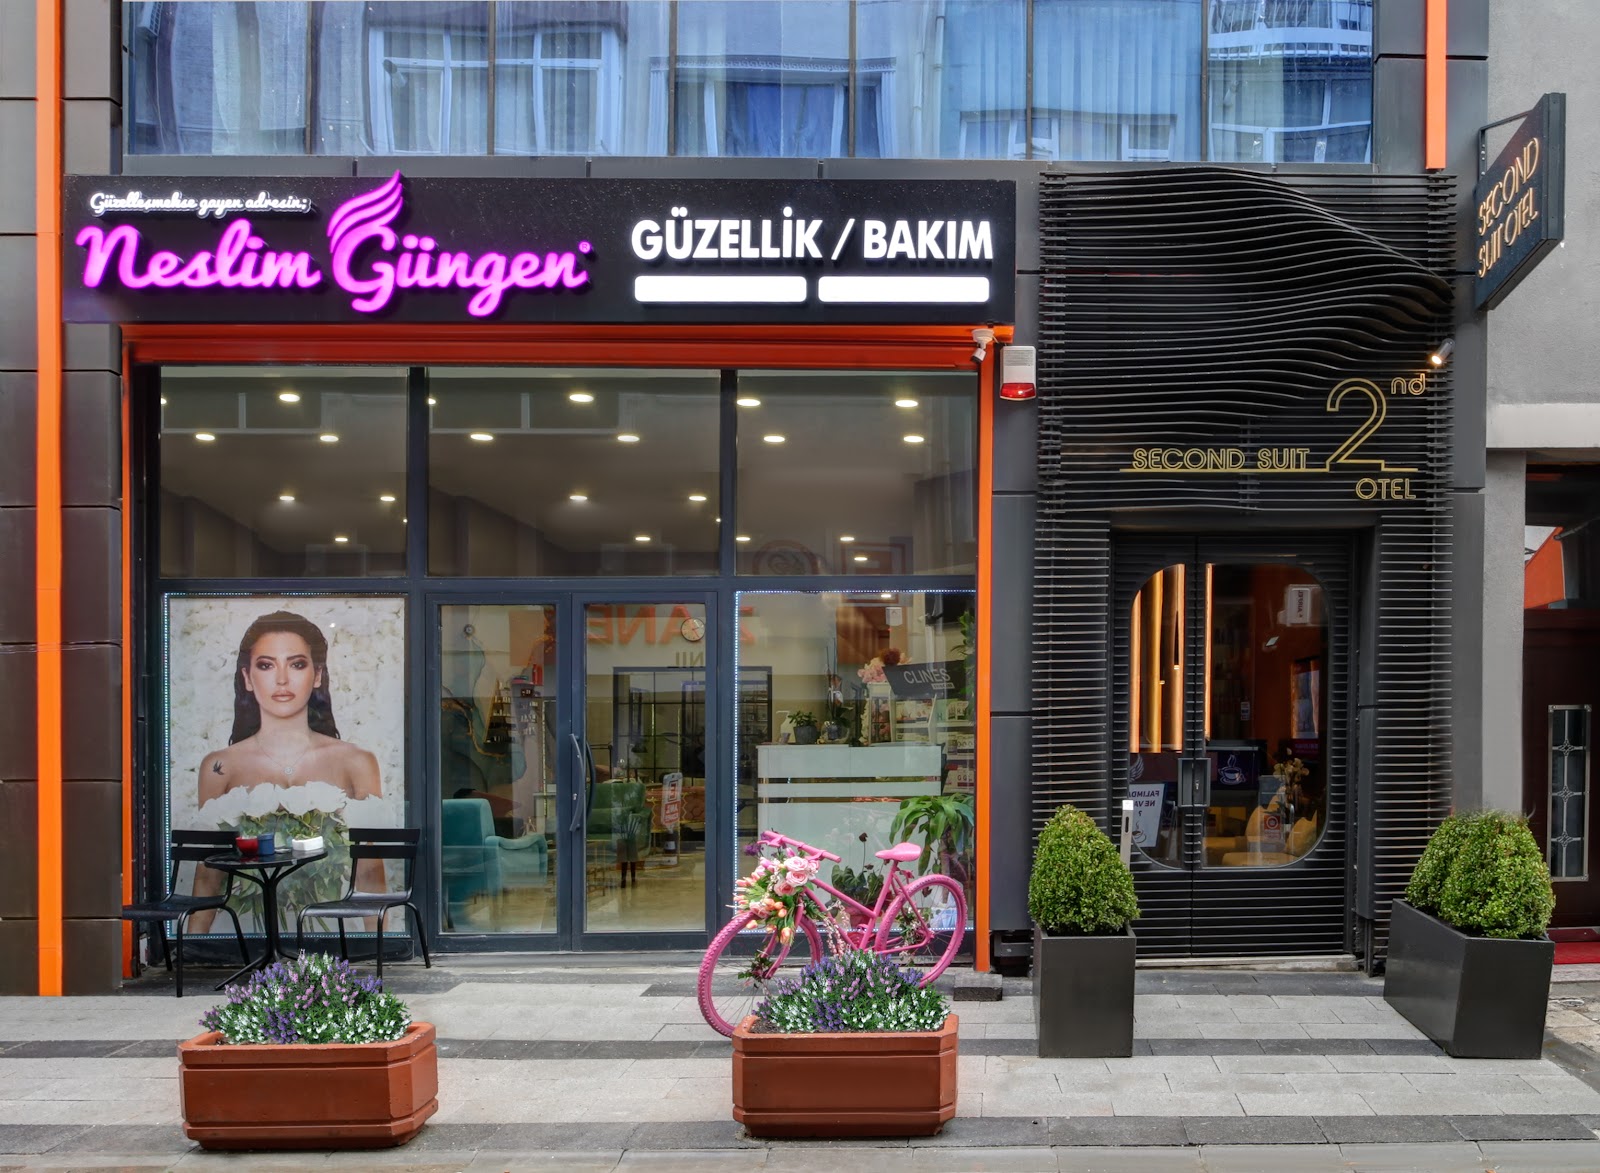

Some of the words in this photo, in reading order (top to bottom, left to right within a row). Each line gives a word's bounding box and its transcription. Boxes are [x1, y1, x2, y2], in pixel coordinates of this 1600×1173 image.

[1478, 138, 1539, 236] SECOND
[75, 219, 322, 289] Neslim
[631, 206, 824, 261] GÜZELLİK
[831, 218, 856, 261] /
[863, 219, 994, 261] BAKIM
[1478, 224, 1503, 278] SUIT
[1504, 188, 1538, 247] OTEL
[1132, 447, 1246, 471] SECOND
[1256, 447, 1311, 470] SUIT
[1354, 477, 1418, 500] OTEL
[903, 668, 951, 684] CLINES
